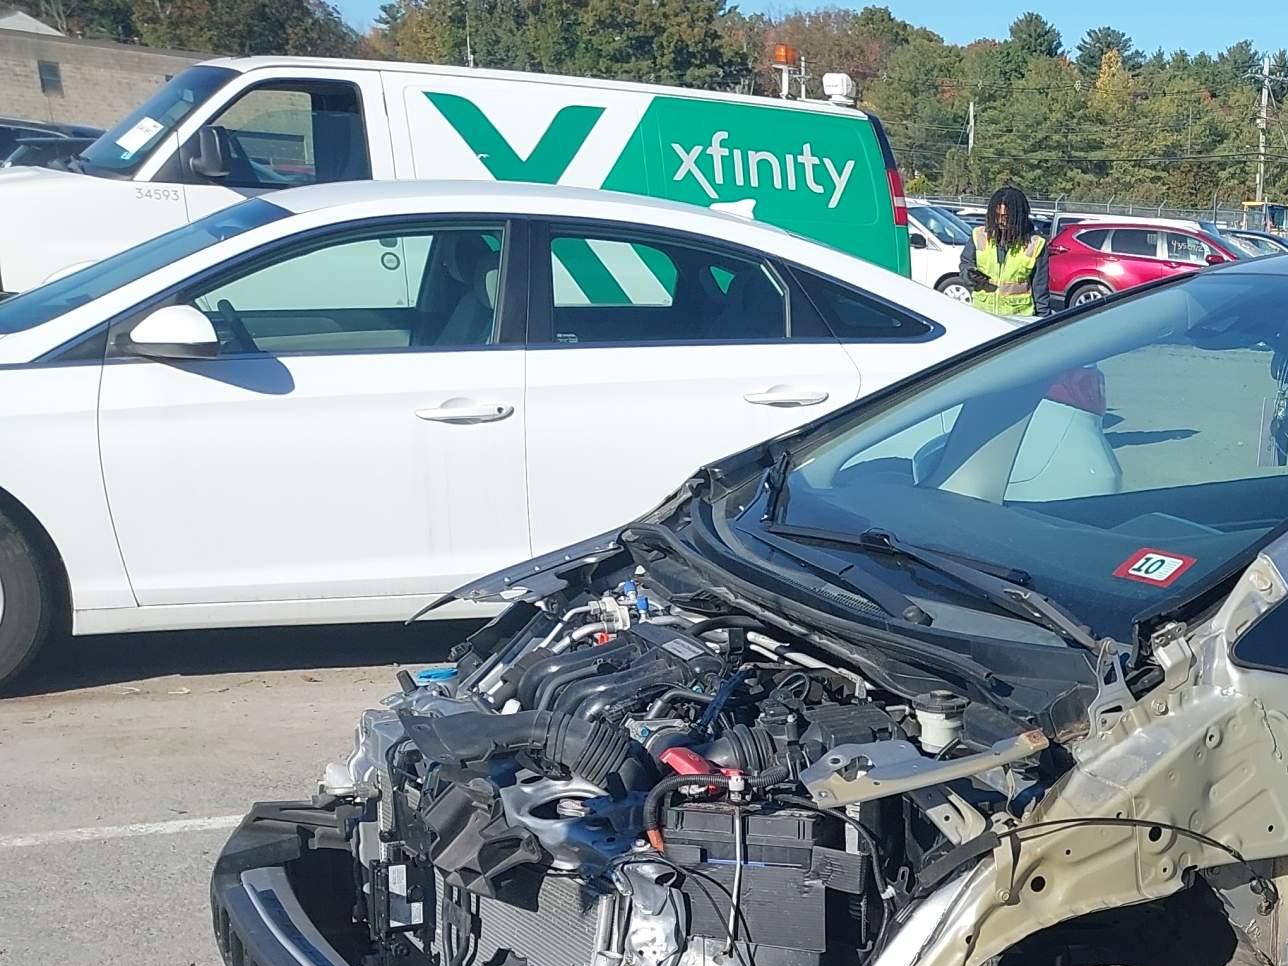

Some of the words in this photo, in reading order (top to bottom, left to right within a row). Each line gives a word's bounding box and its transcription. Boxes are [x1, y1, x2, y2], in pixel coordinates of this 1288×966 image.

[671, 131, 855, 208] xfinity
[135, 188, 180, 201] 34593
[1131, 556, 1166, 575] 10
